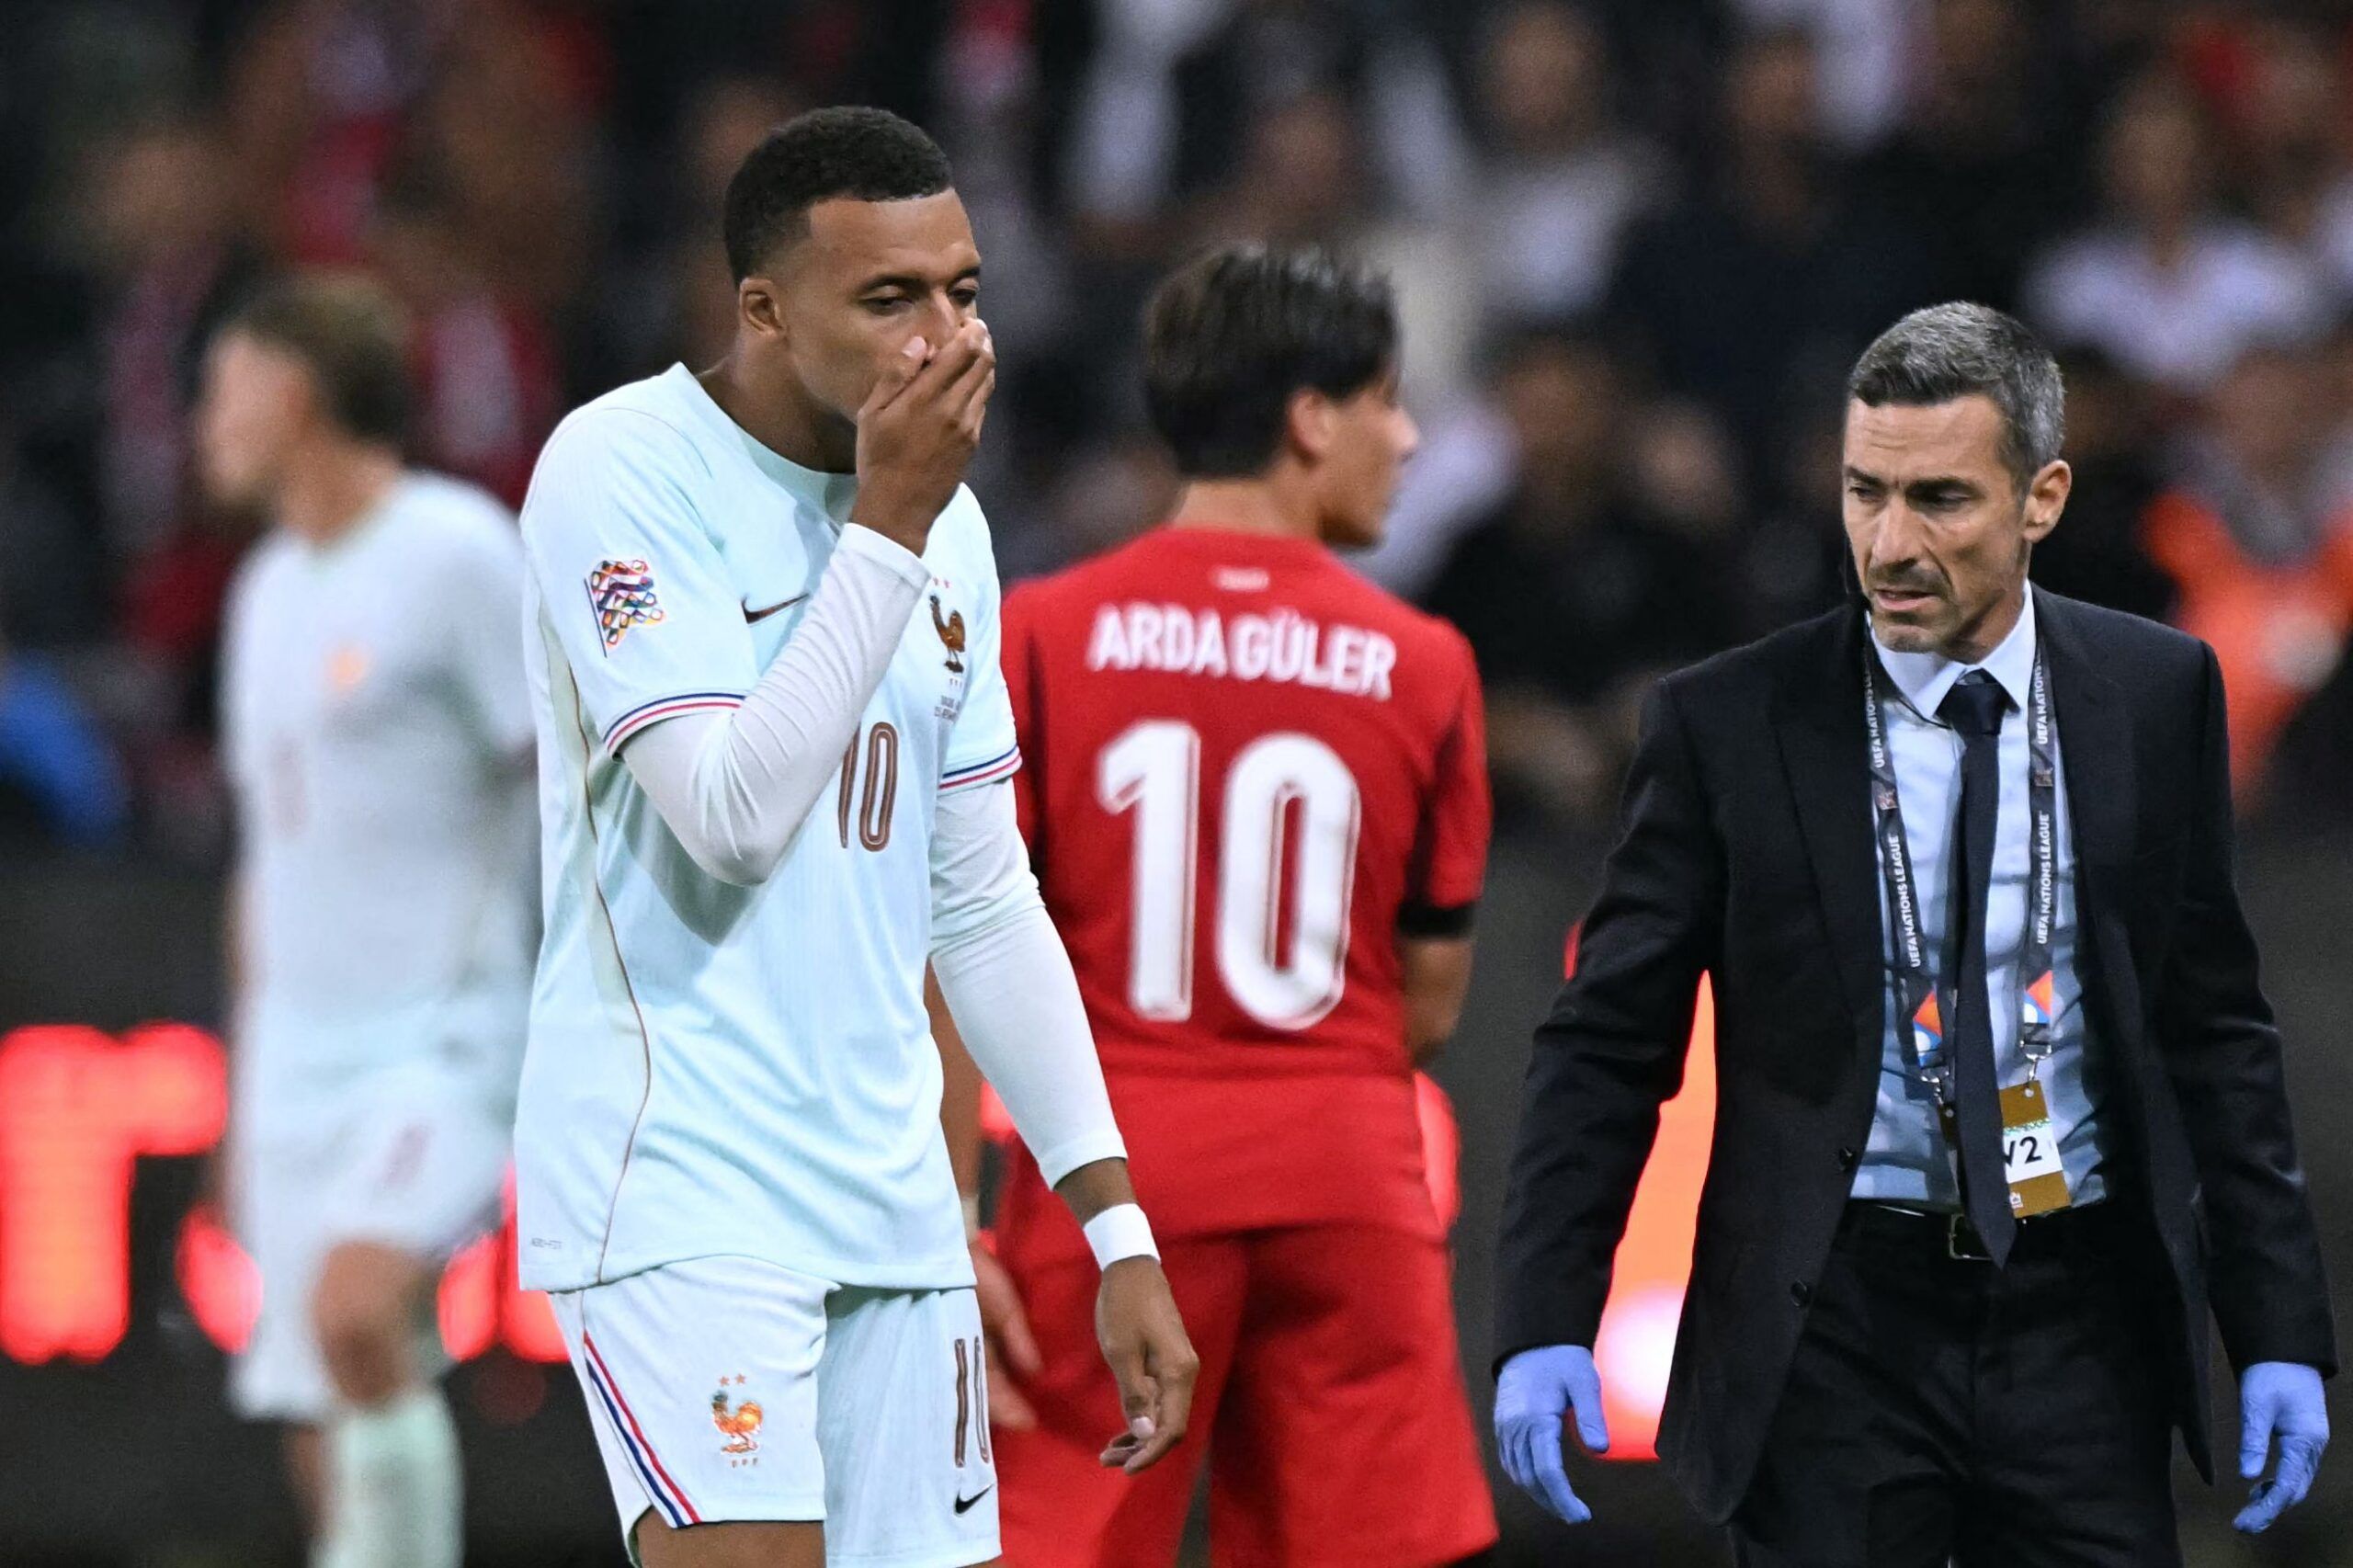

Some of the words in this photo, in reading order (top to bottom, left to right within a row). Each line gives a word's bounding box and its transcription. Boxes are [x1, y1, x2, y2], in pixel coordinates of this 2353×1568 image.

[1087, 604, 1228, 677] ARDA
[1229, 607, 1396, 701] GÜLER
[2034, 665, 2047, 714] NATIONS
[1872, 738, 1885, 768] UEFA
[2037, 716, 2048, 744] UEFA
[1888, 835, 1906, 882] LEAGUE
[2039, 813, 2052, 860] LEAGUE
[1096, 718, 1361, 1031] 10
[2040, 861, 2052, 915] NATIONS
[1897, 883, 1915, 937] NATIONS
[2037, 915, 2048, 945] UEFA
[1907, 939, 1921, 968] UEFA
